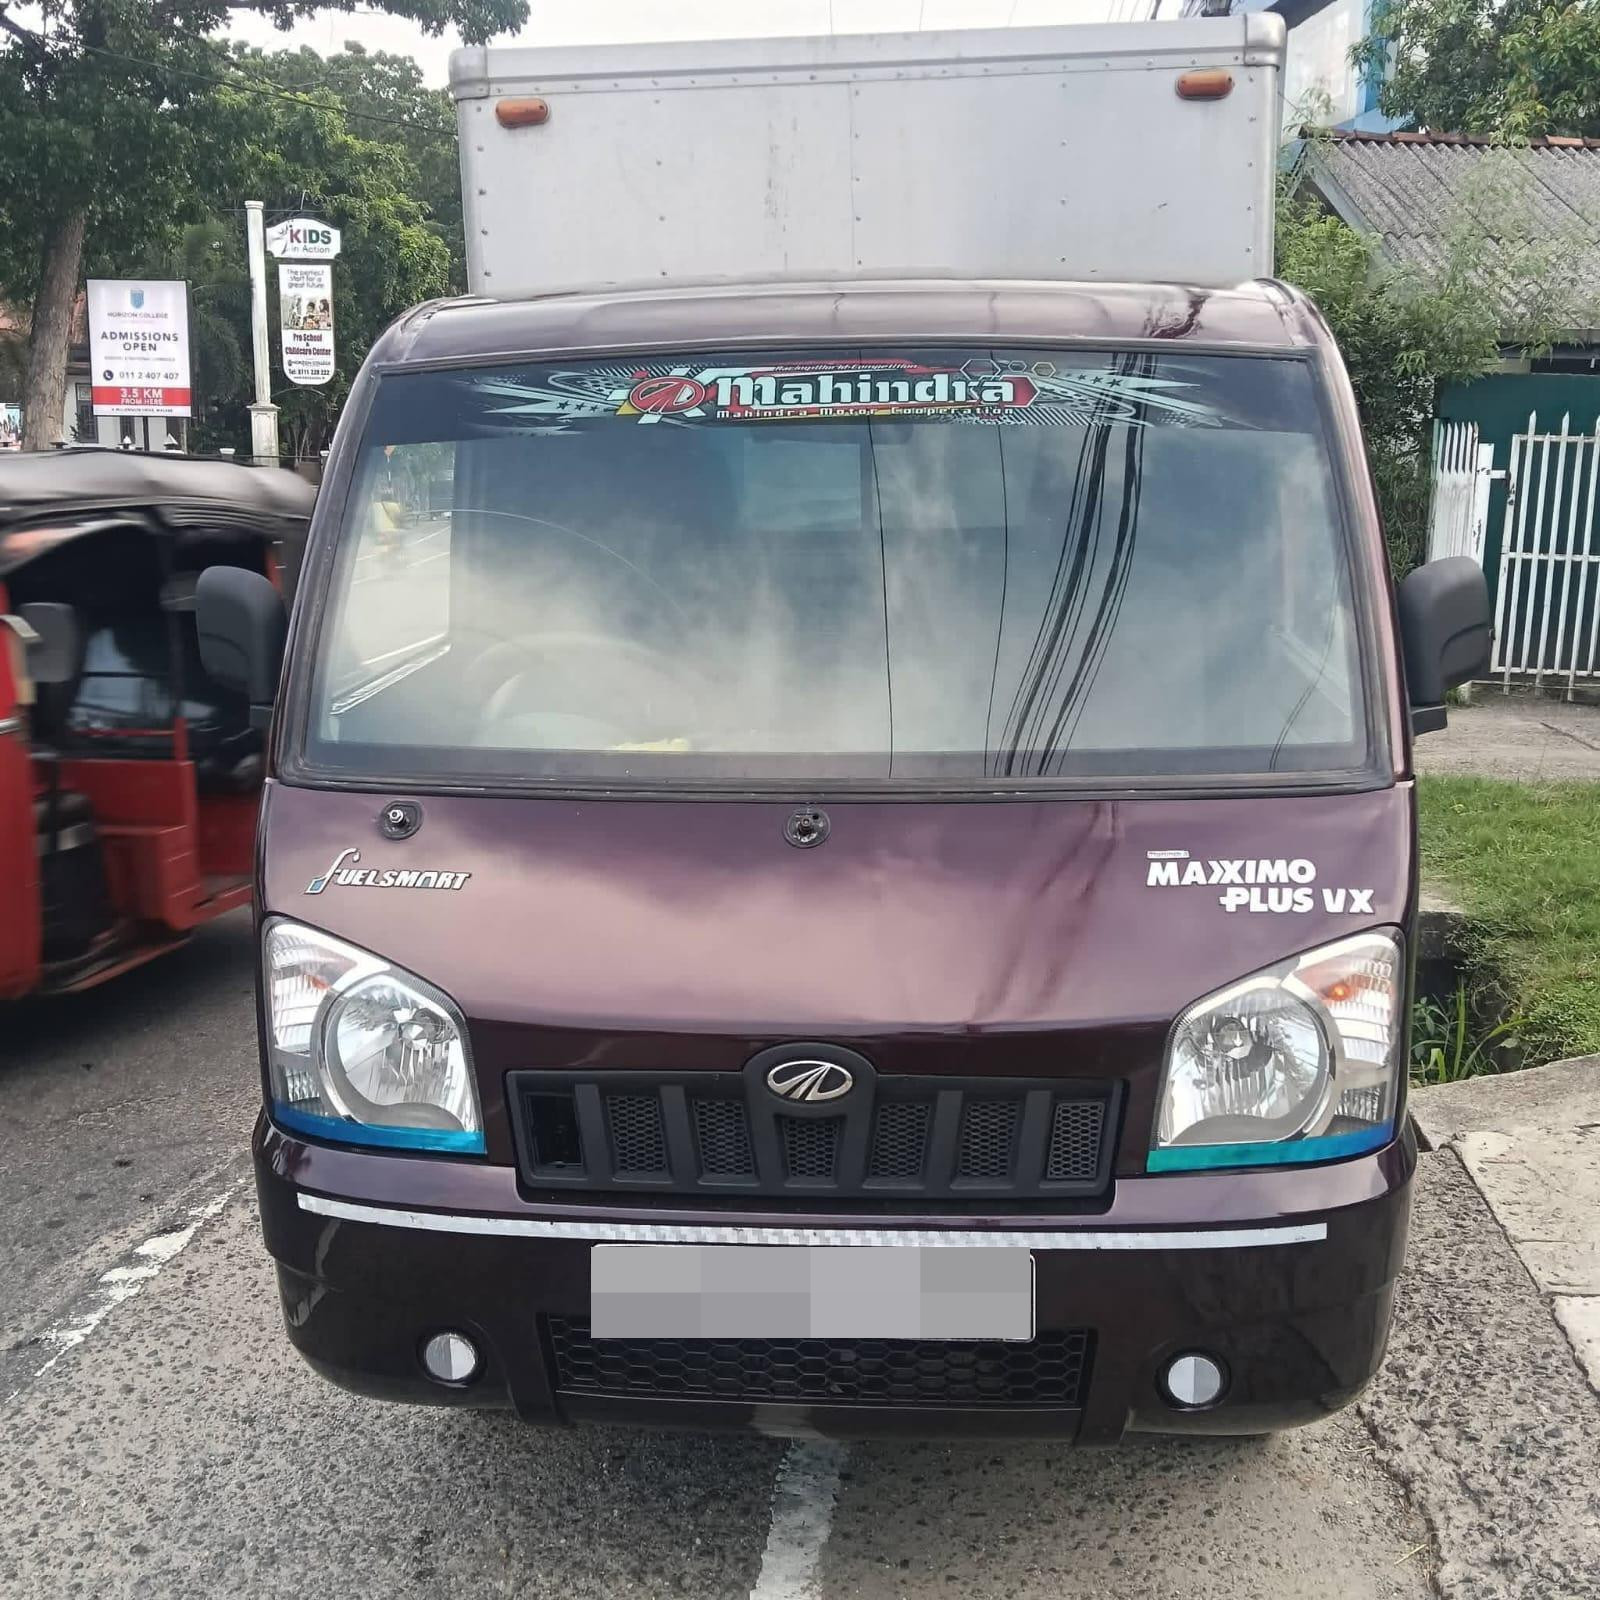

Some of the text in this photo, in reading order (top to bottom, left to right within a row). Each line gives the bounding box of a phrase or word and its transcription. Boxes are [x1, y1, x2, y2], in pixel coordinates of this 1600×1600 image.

[289, 229, 332, 244] KIDS
[302, 245, 330, 254] Action
[101, 331, 179, 342] ADMISSIONS
[303, 333, 322, 342] School
[123, 342, 157, 351] OPEN
[119, 371, 135, 379] 011
[145, 372, 161, 380] 407
[164, 372, 179, 380] 407
[120, 388, 163, 399] 3.5 KM
[717, 374, 1014, 406] Mahindra
[144, 398, 163, 406] HERE
[717, 408, 807, 419] Mahindra
[820, 407, 877, 416] Motor
[1322, 888, 1375, 914] VX
